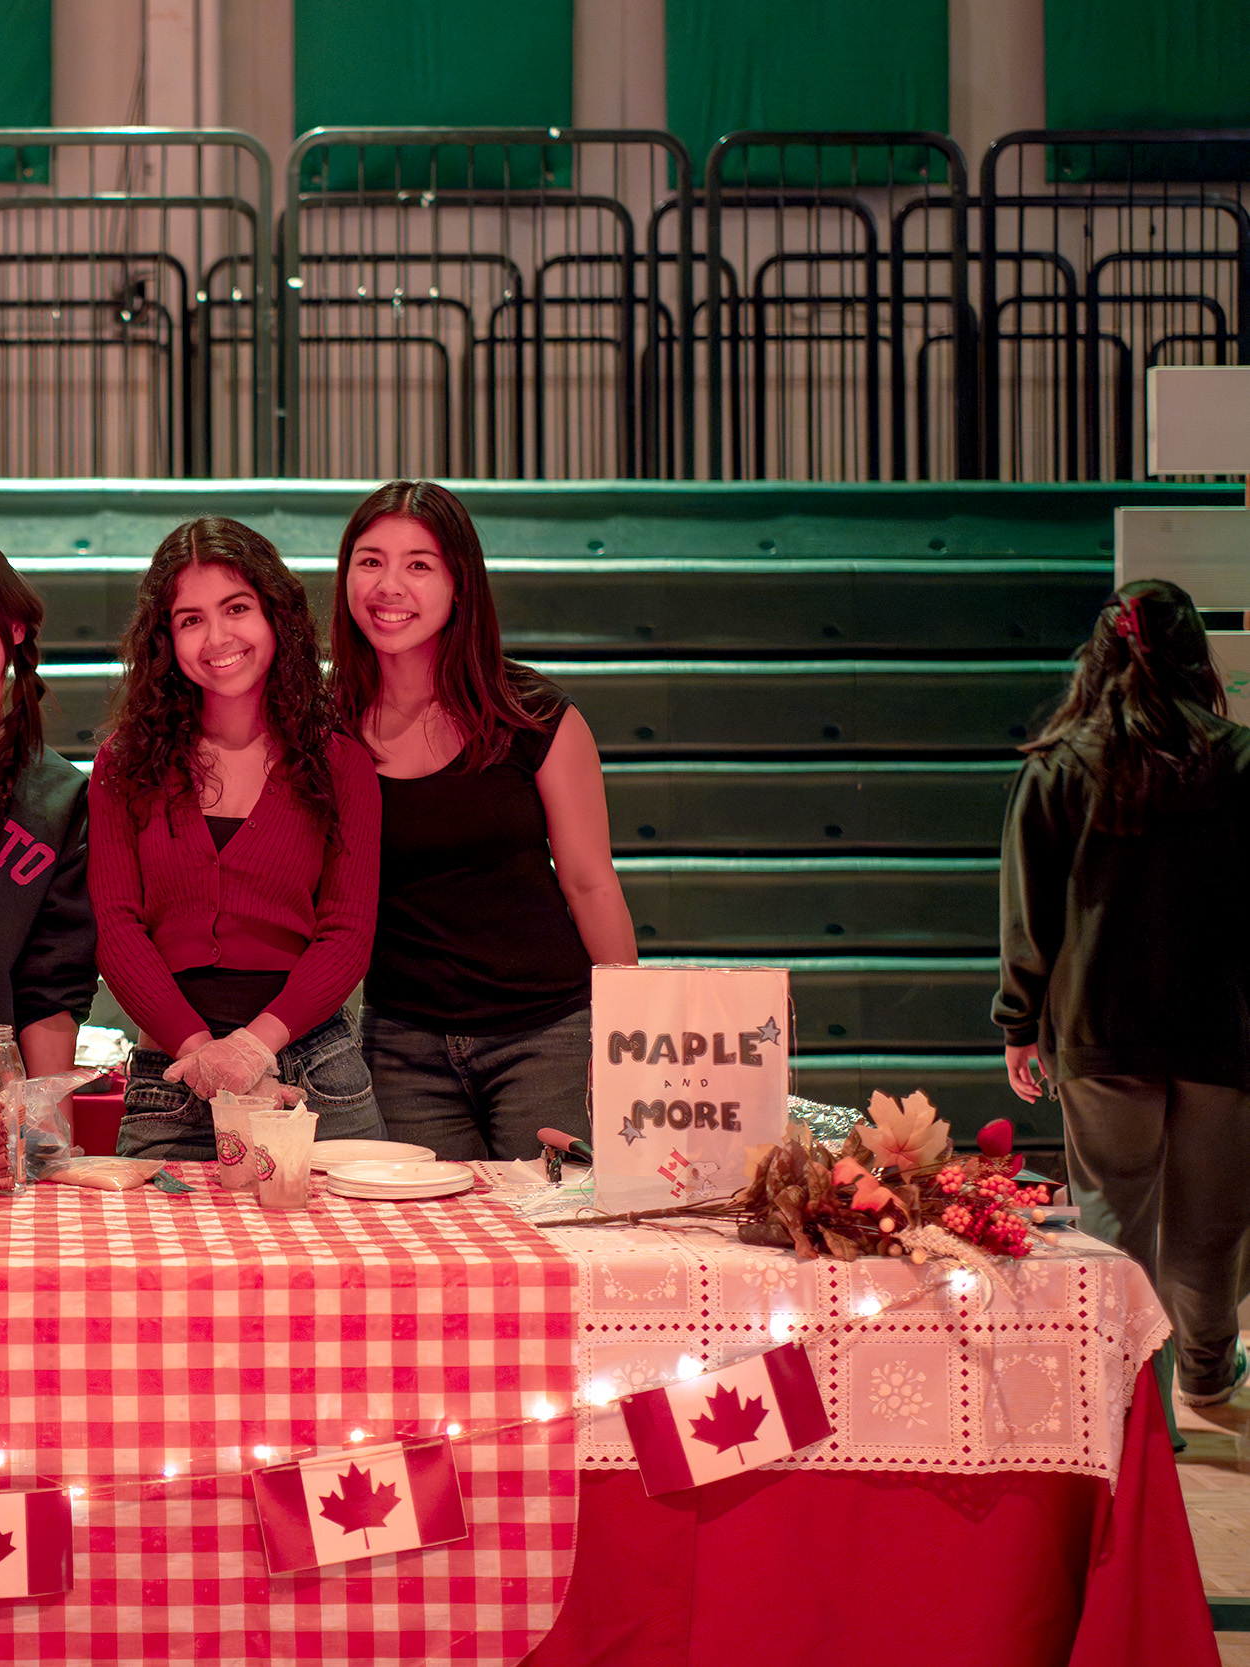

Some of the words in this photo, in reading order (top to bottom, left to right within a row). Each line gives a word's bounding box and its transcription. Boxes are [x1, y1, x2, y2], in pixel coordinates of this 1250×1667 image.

[608, 1030, 763, 1067] MAPLE
[664, 1078, 708, 1089] AND
[631, 1099, 742, 1132] MORE
